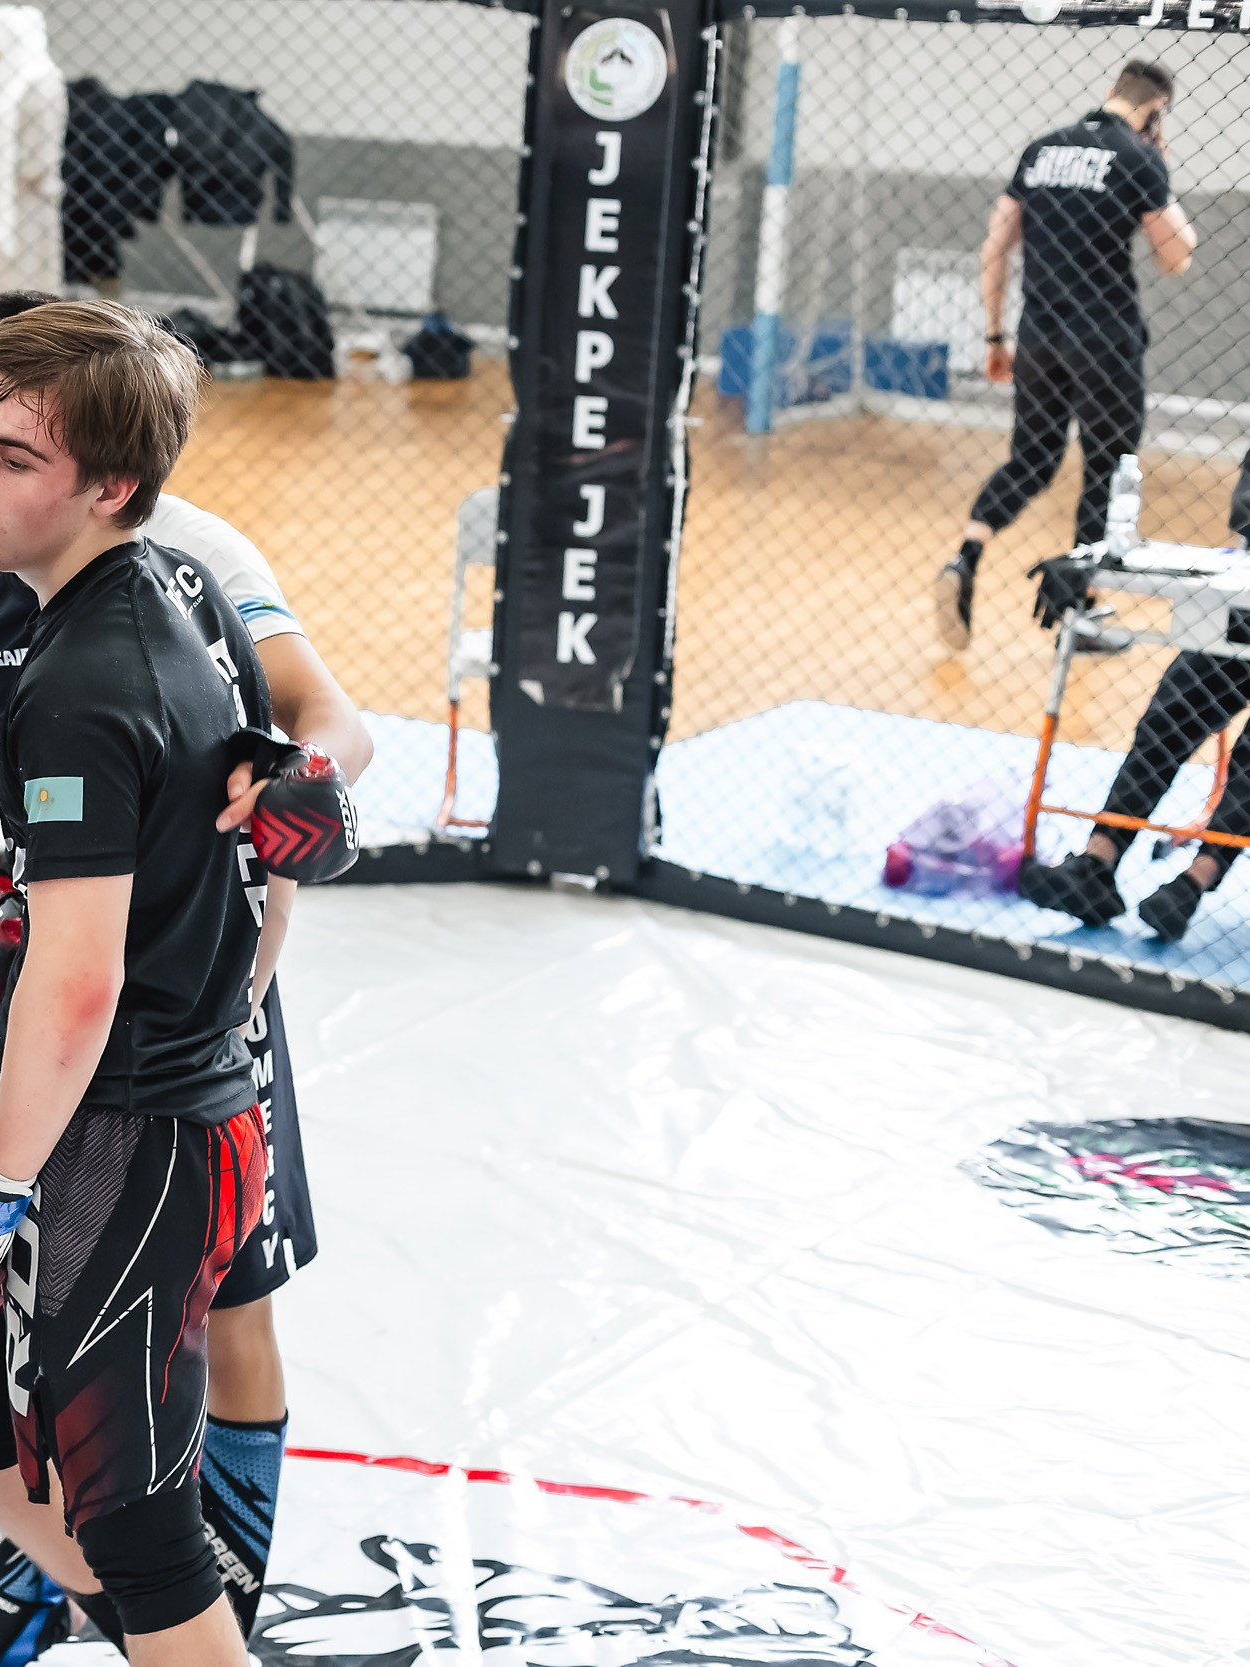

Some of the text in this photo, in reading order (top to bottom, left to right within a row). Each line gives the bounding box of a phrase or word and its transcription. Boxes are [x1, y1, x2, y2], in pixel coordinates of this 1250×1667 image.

[1023, 145, 1117, 193] JUDGE
[571, 131, 623, 450] JEKPE
[556, 485, 606, 665] JEK
[335, 789, 355, 850] RDX
